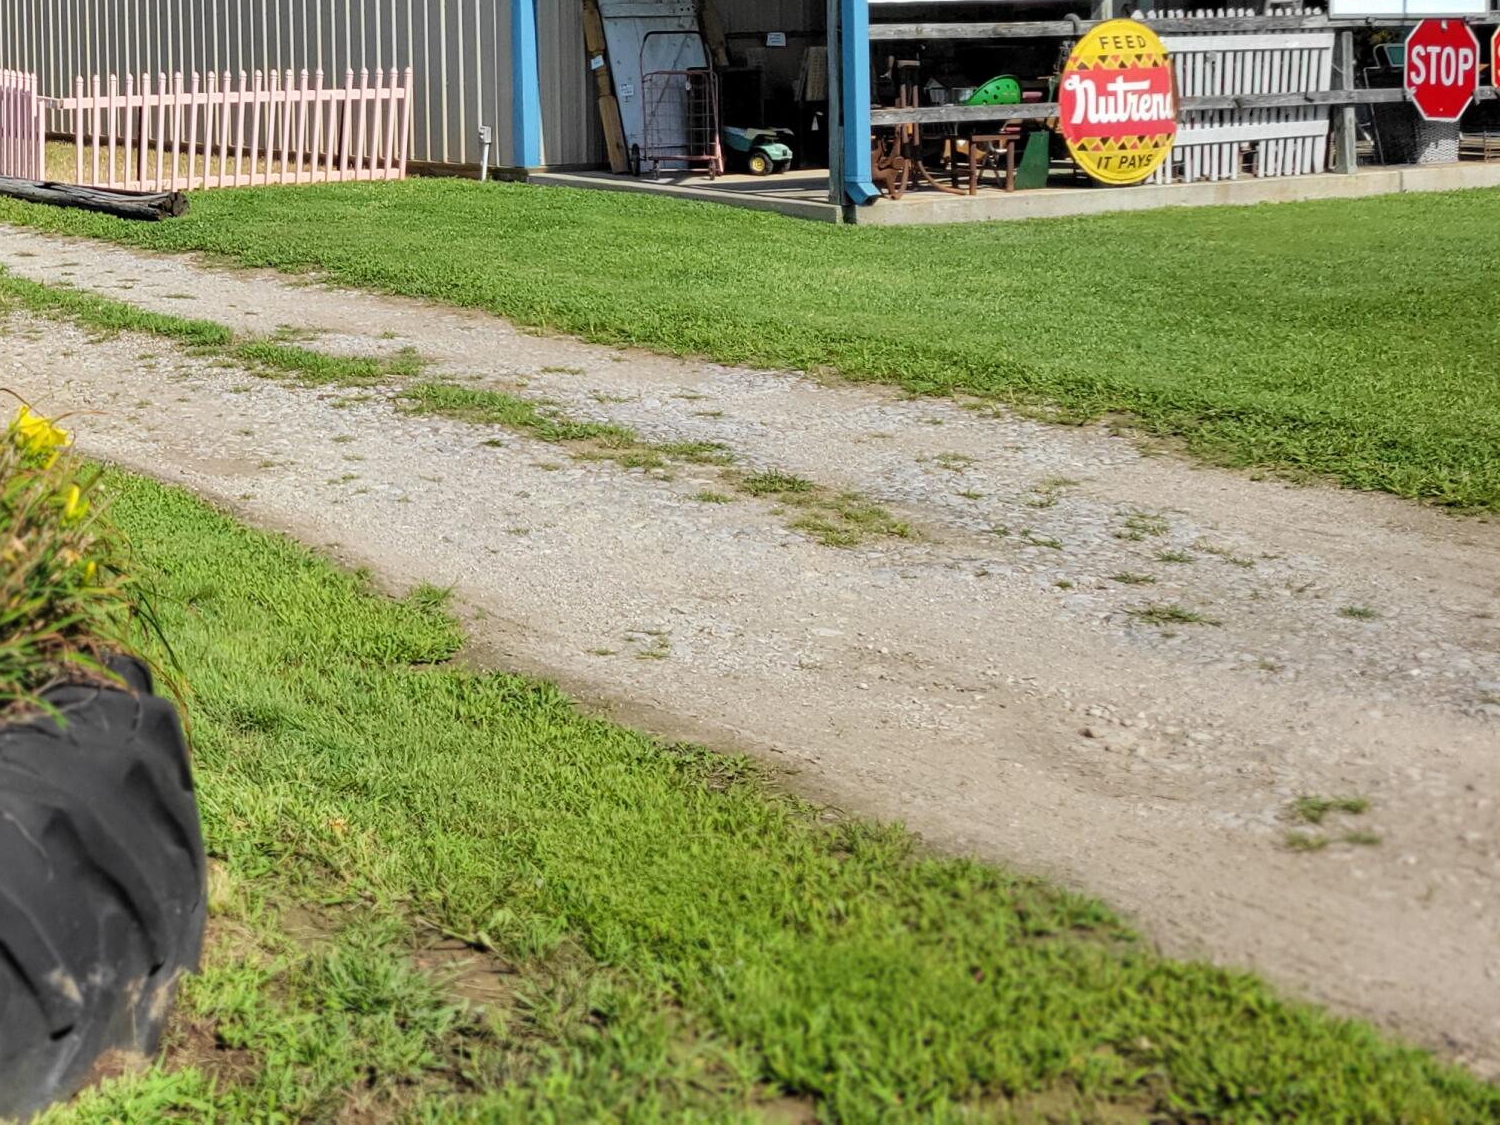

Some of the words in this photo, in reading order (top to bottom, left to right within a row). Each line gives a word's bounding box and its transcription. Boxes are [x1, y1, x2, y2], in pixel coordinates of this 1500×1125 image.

[1099, 34, 1148, 50] FEED
[1410, 44, 1474, 87] STOP
[1096, 156, 1112, 170] IT
[1118, 153, 1154, 170] PAYS
